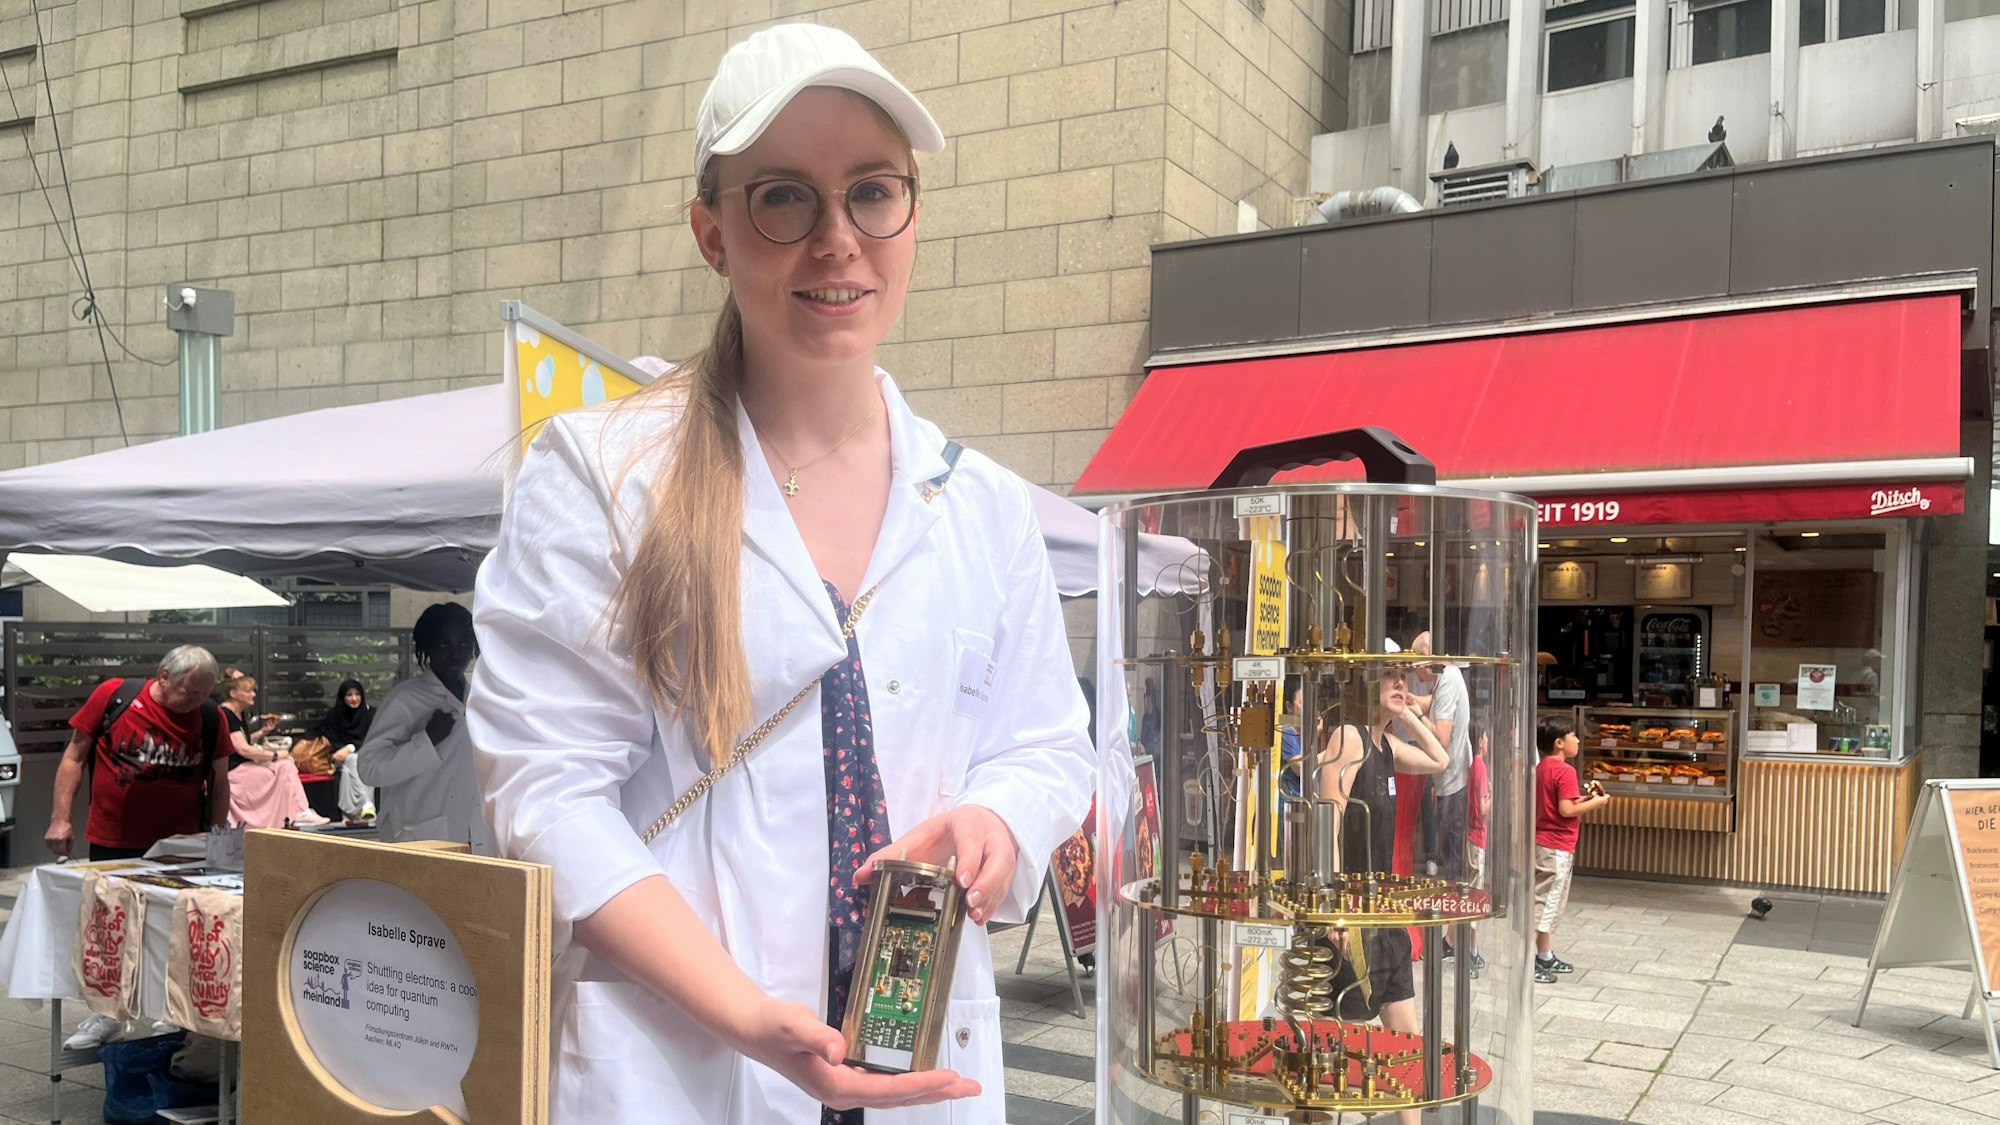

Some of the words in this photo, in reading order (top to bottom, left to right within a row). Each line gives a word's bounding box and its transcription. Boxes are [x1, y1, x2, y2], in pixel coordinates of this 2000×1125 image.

[1870, 487, 1921, 511] Ditsch
[1538, 504, 1566, 522] EIT
[1570, 501, 1620, 522] 1919
[1965, 806, 1985, 815] HIER
[1978, 818, 1996, 830] DIE
[368, 922, 406, 941] Isabelle
[409, 930, 446, 949] Sprave
[303, 950, 340, 965] soapbox
[303, 960, 334, 975] science
[367, 962, 403, 983] Shuttling
[406, 972, 448, 991] electrons:
[451, 982, 456, 992] a
[303, 988, 341, 1008] rheinland
[366, 980, 384, 994] idea
[386, 984, 398, 997] for
[401, 989, 438, 1007] quantum
[366, 1000, 410, 1022] computing
[430, 1040, 440, 1048] and
[440, 1042, 458, 1052] RWTH
